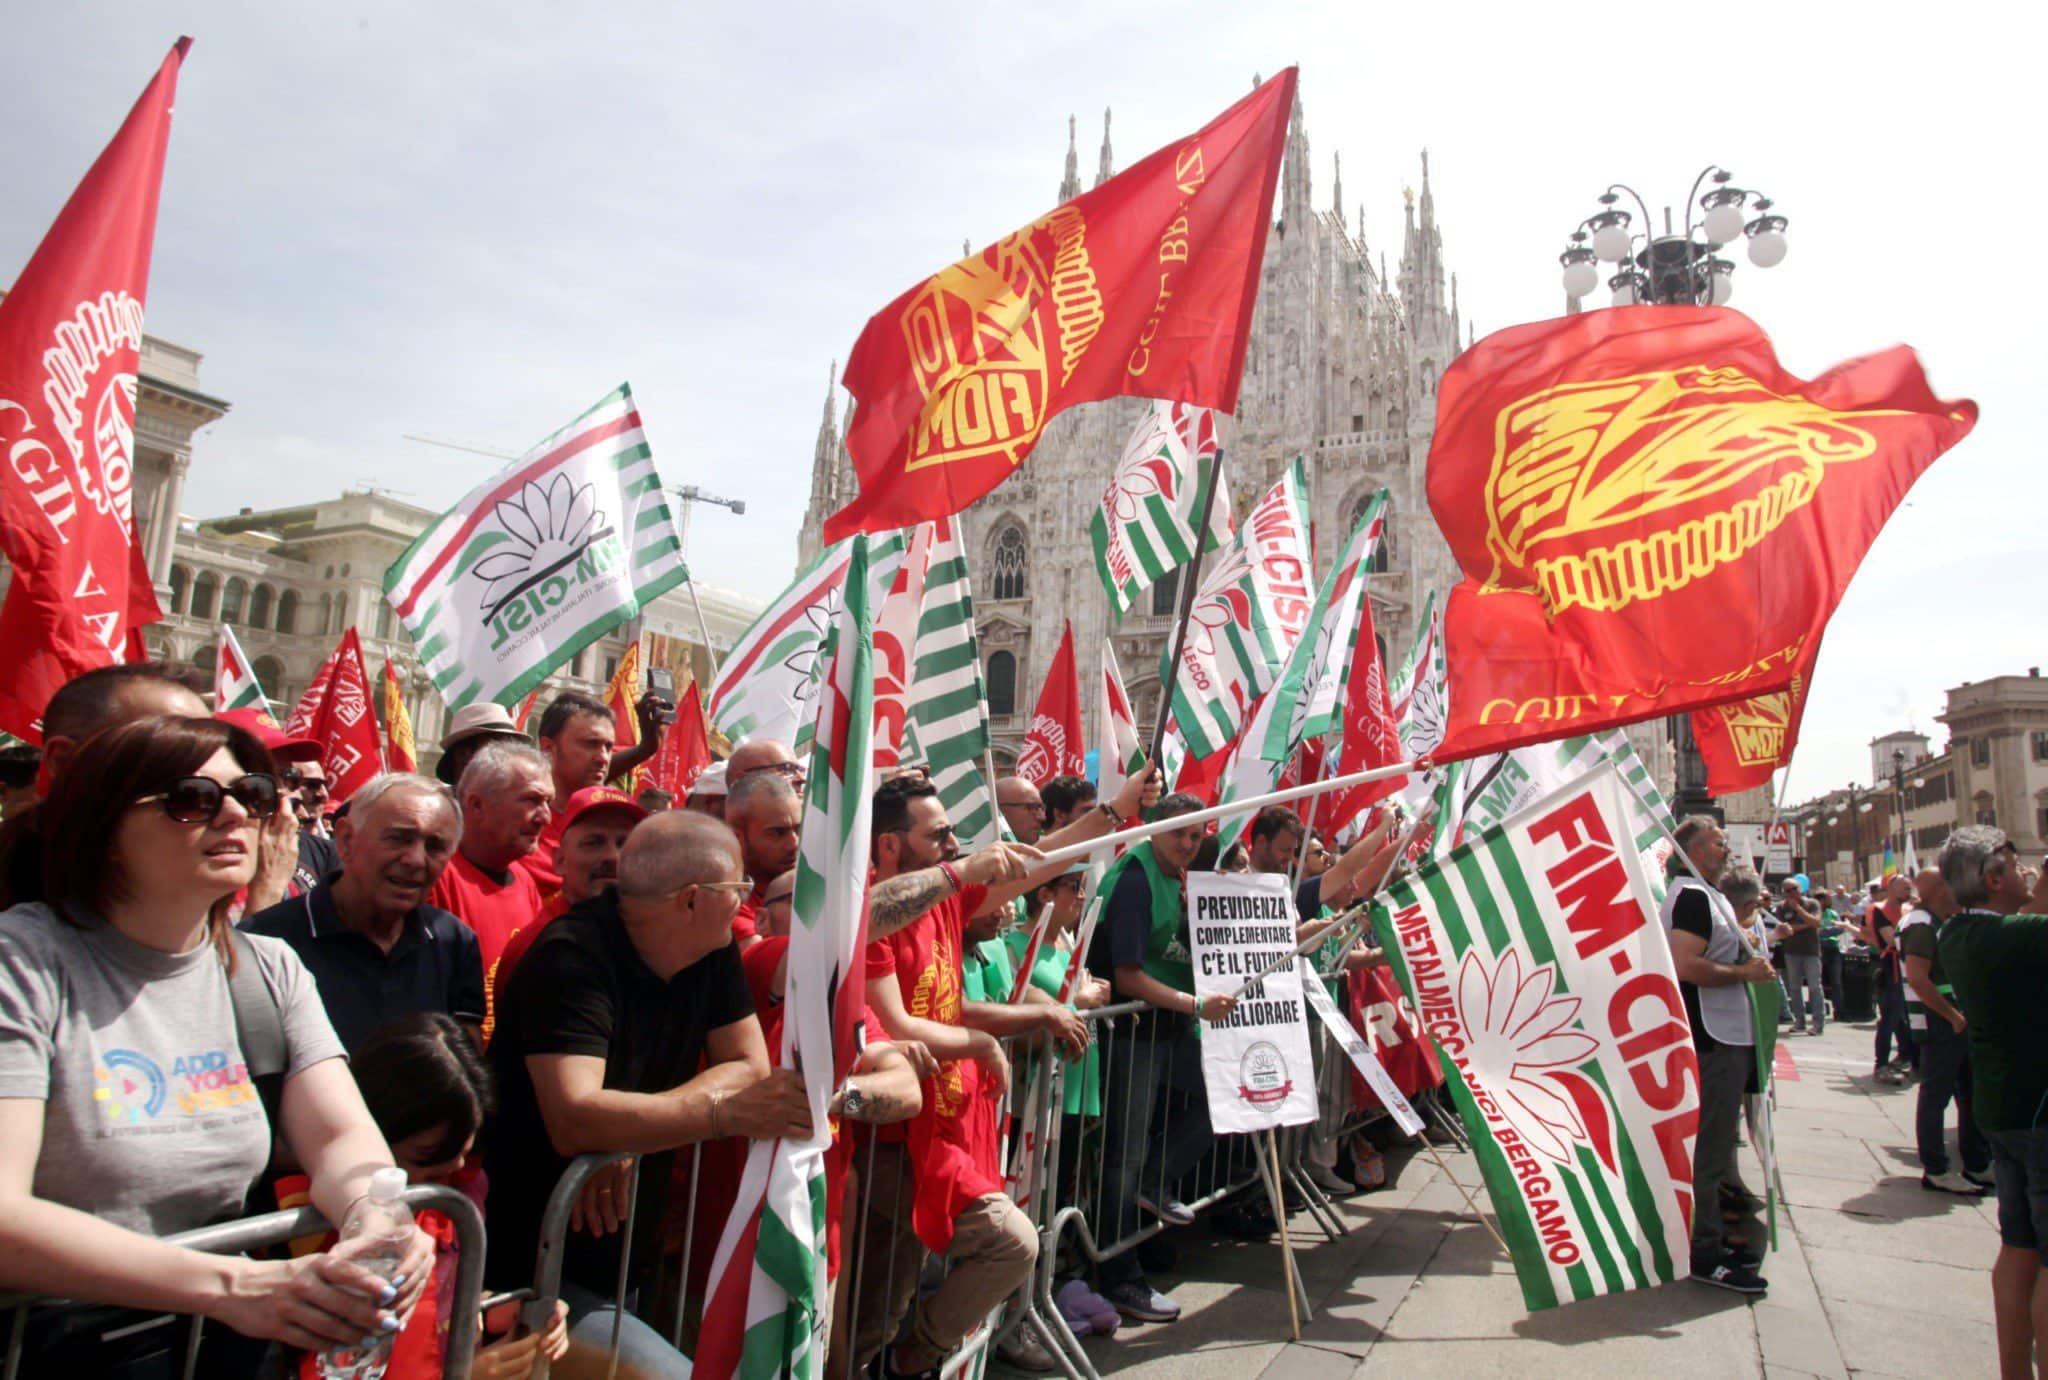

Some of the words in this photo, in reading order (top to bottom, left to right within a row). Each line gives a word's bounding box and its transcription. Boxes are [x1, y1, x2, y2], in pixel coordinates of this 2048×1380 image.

[1180, 645, 1211, 693] LECCO
[1197, 895, 1288, 921] PREVIDENZA
[1196, 926, 1293, 946] COMPLEMENTARE
[1201, 948, 1226, 976] C'È
[1228, 952, 1242, 975] IL
[1244, 951, 1294, 974] FUTURO
[1526, 790, 1700, 1186] FIM-CISL
[173, 1050, 229, 1076] ADD
[1393, 902, 1500, 1127] METALMECCANICI
[1493, 1128, 1581, 1266] BERGAMO
